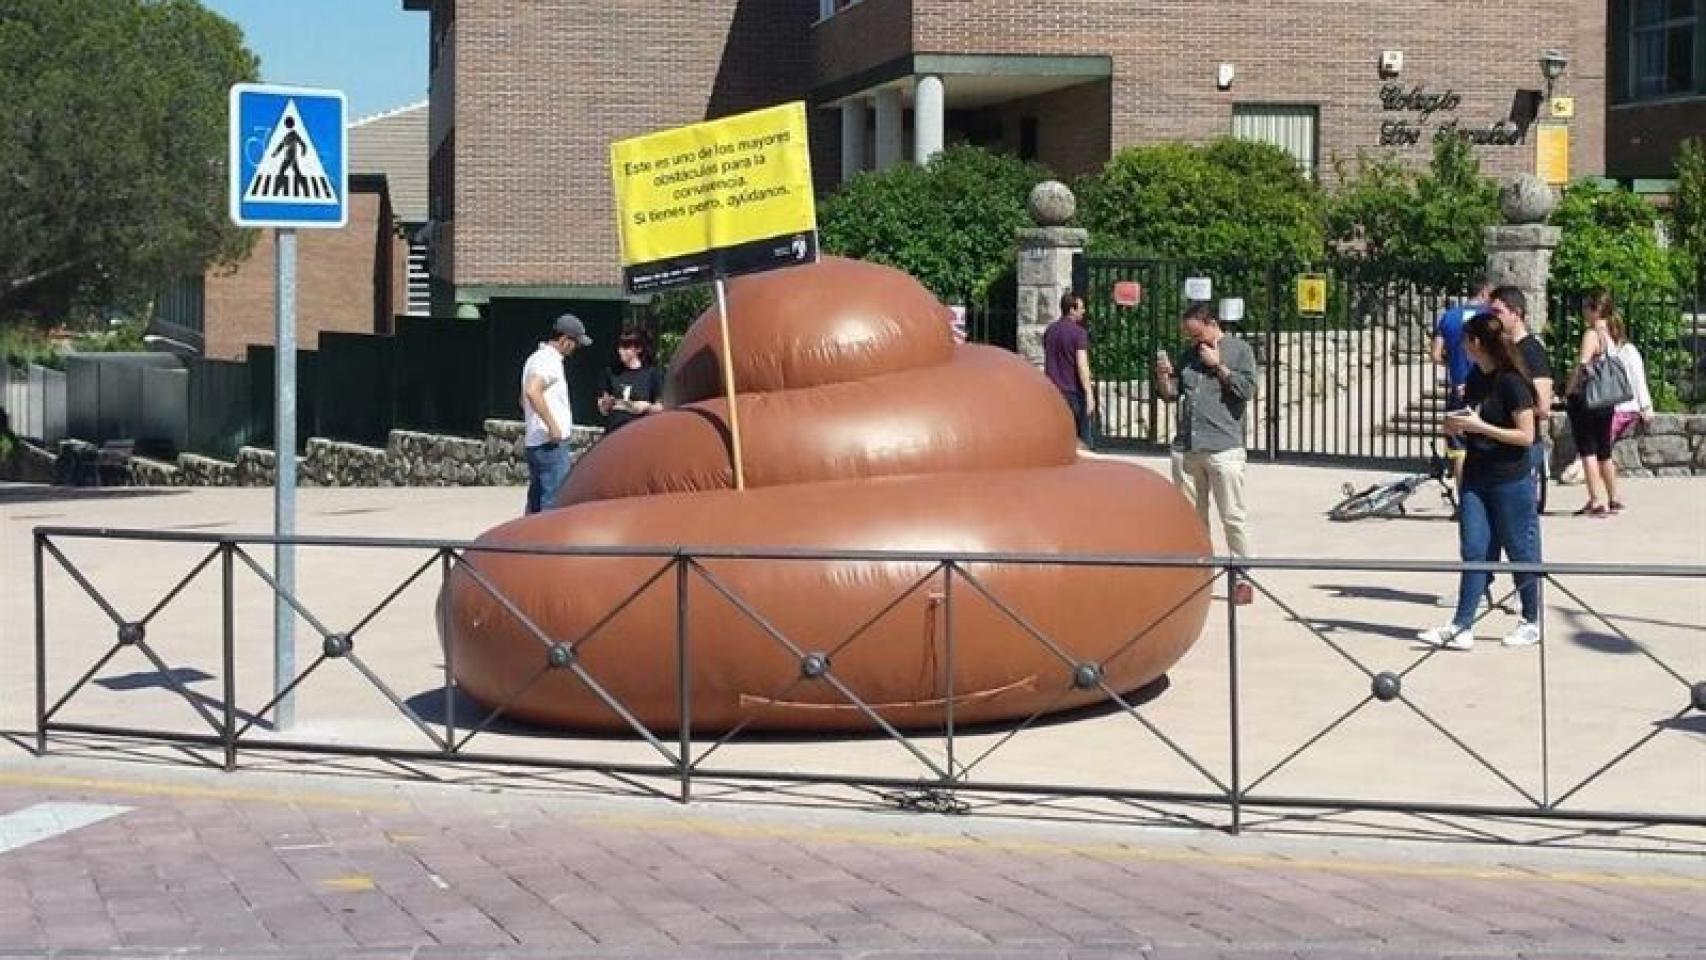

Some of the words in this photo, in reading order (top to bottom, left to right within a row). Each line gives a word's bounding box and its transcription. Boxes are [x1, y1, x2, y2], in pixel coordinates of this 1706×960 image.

[625, 161, 651, 176] Este
[655, 158, 670, 169] es
[673, 152, 695, 165] uno
[697, 145, 712, 160] de
[713, 143, 735, 156] los
[738, 131, 791, 151] mayores
[721, 157, 752, 175] para
[754, 154, 765, 166] la
[633, 211, 646, 225] Si
[649, 205, 686, 222] tienes
